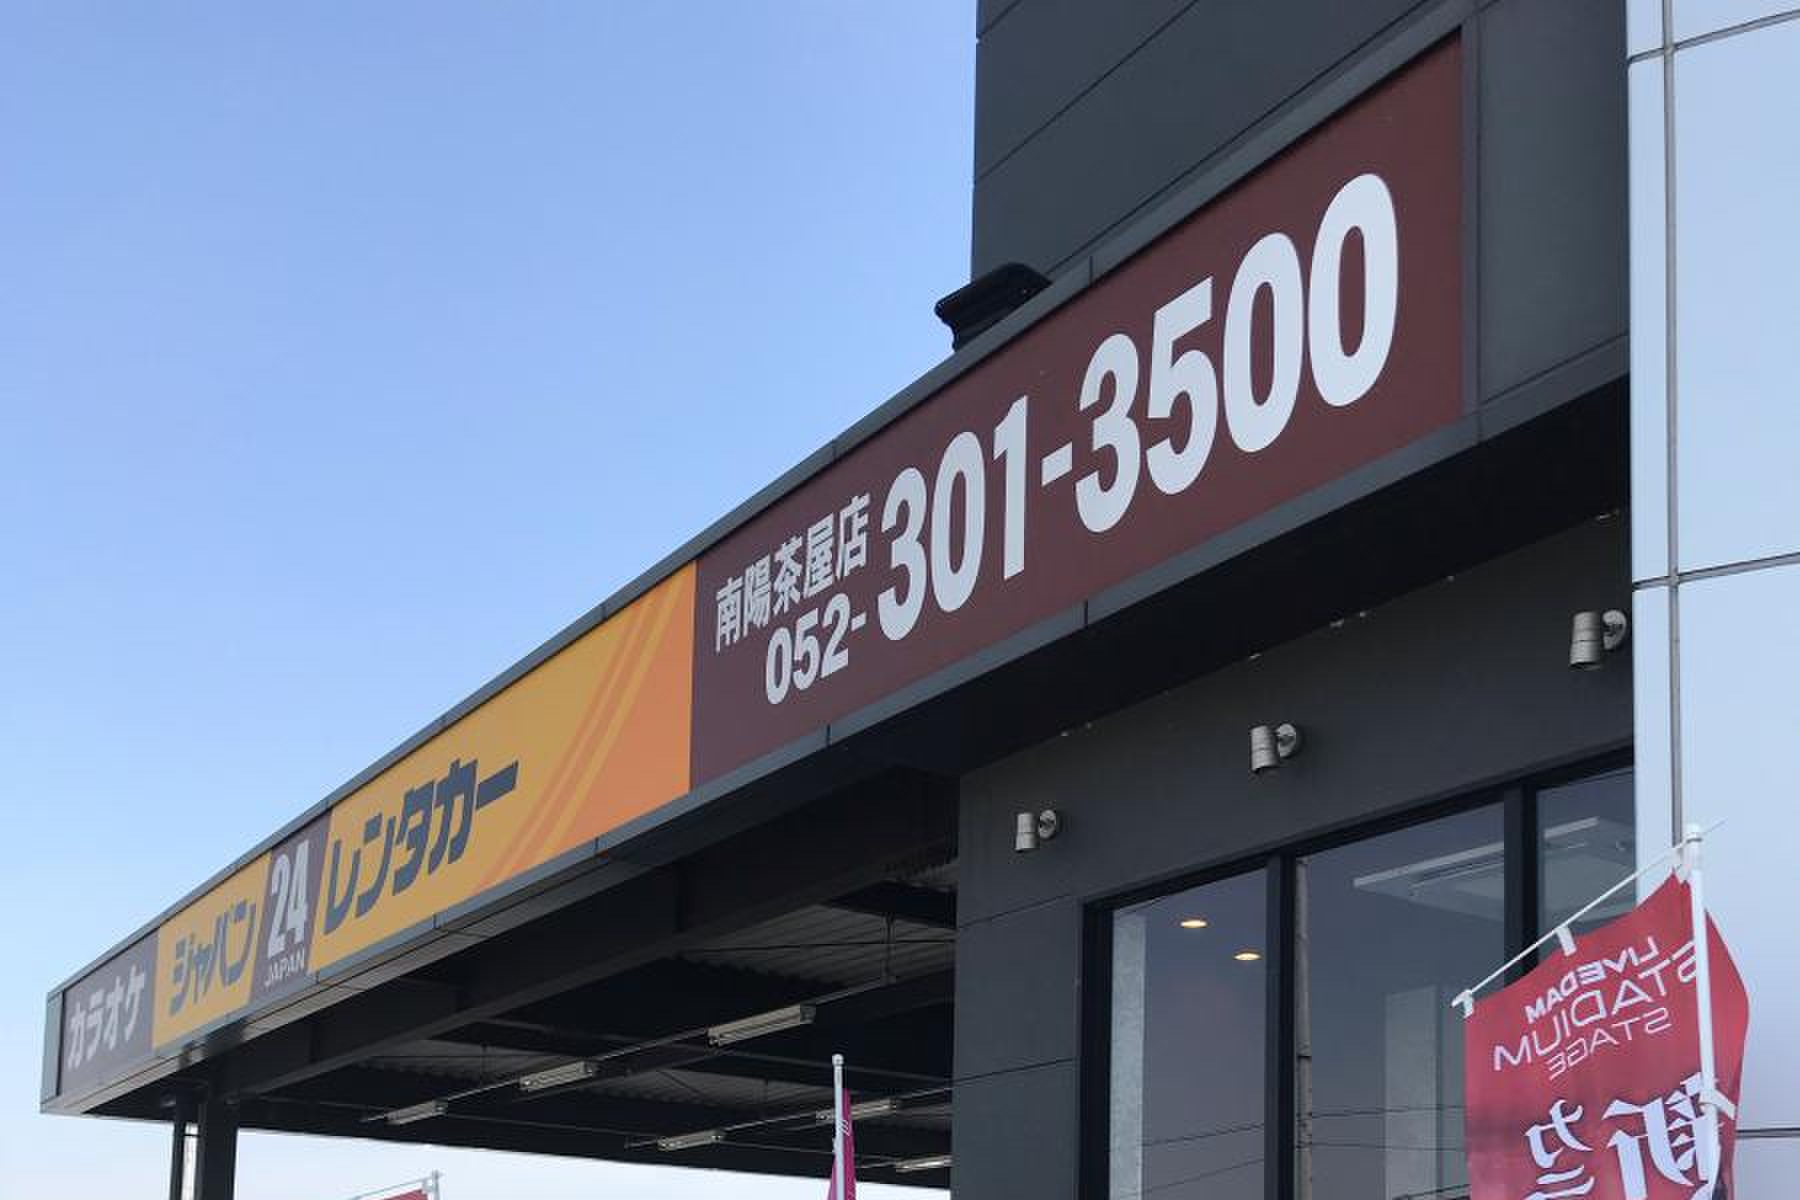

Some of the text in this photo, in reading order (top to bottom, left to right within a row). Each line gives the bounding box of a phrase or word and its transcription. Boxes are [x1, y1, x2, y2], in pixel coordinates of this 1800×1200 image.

[715, 492, 871, 654] 南陽茶屋店
[68, 963, 146, 1069] カラオケ
[266, 838, 309, 959] 24
[323, 758, 518, 934] レンタカー
[264, 950, 306, 989] JAPAN
